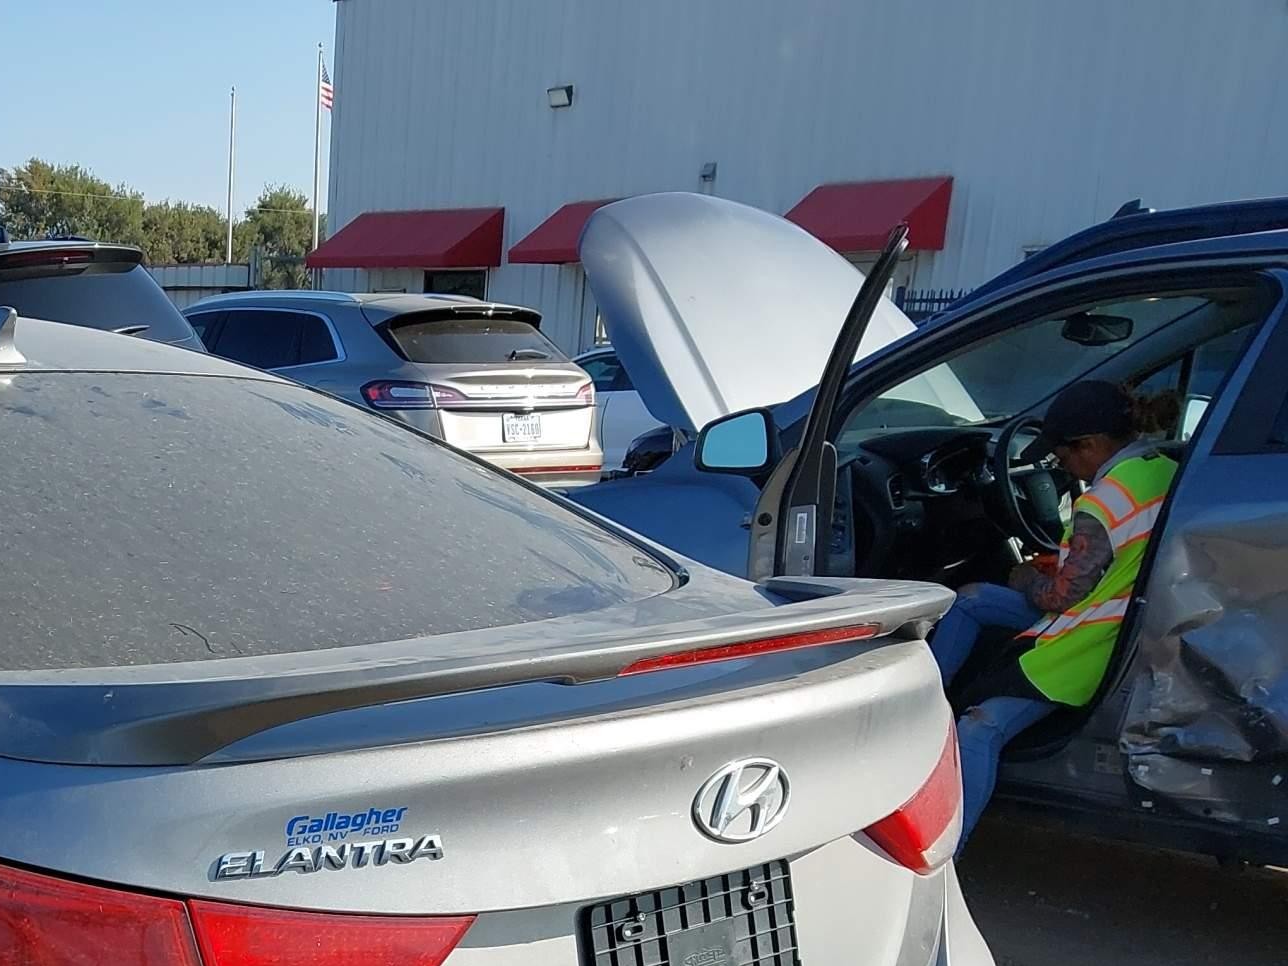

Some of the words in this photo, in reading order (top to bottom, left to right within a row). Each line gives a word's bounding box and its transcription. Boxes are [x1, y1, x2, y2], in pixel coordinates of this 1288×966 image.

[286, 807, 408, 837] Gallagher
[287, 835, 325, 846] ELKO,
[329, 831, 348, 842] NV
[362, 824, 400, 836] FORD
[208, 834, 444, 882] ELANTRA
